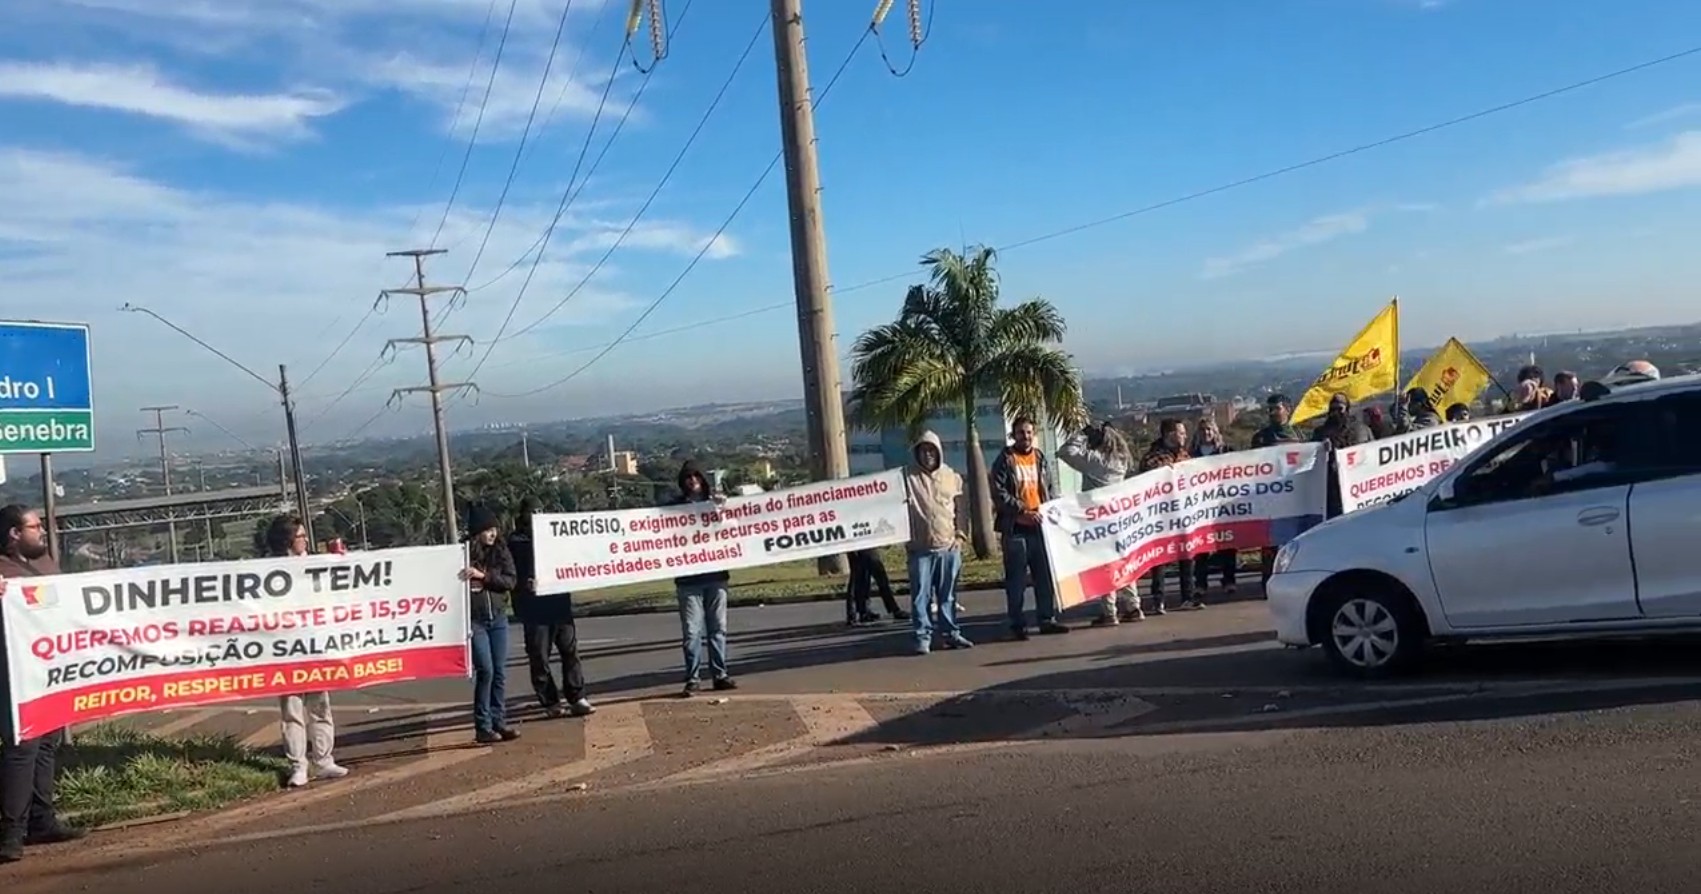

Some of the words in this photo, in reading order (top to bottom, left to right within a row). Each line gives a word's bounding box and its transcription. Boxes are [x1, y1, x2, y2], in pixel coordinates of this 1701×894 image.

[0, 418, 88, 441] enebra
[1379, 425, 1481, 466] DINHEIRO
[1487, 418, 1520, 438] TE
[1085, 493, 1140, 522] SAÚDE
[1143, 480, 1173, 503] NÃO
[1177, 475, 1186, 490] É
[1190, 463, 1273, 487] COMÉRCIO
[1349, 465, 1425, 498] QUEREMOS
[1429, 458, 1459, 476] RE
[550, 515, 625, 537] TARCÍSIO,
[629, 512, 696, 534] exigimos
[701, 501, 761, 528] garantia
[765, 498, 783, 512] do
[787, 479, 888, 509] financiamento
[609, 543, 618, 554] e
[623, 535, 687, 553] aumento
[692, 530, 710, 544] de
[715, 518, 779, 542] recursos
[783, 513, 815, 534] para
[819, 510, 836, 522] as
[1071, 511, 1143, 546] TARCÍSIO,
[1148, 499, 1179, 517] TIRE
[1184, 492, 1198, 509] AS
[1202, 484, 1250, 501] MÃOS
[1256, 480, 1294, 495] DOS
[1114, 520, 1164, 553] NOSSOS
[1169, 502, 1253, 531] HOSPITAIS!
[555, 557, 661, 580] universidades
[666, 543, 743, 567] estaduais!
[764, 524, 846, 551] FORUM
[1167, 542, 1175, 554] É
[1206, 530, 1234, 544] SUS
[81, 569, 292, 616] DINHEIRO
[305, 561, 392, 593] TEM!
[31, 621, 178, 661] QUEREMOS
[188, 607, 326, 637] REAJUSTE
[332, 603, 363, 623] DE
[369, 596, 447, 620] 15,97%
[46, 637, 263, 687] RECOMPOSIÇÃO
[396, 620, 433, 644] JÁ!
[74, 685, 156, 712] REITOR,
[164, 672, 265, 698] RESPEITE
[271, 671, 287, 686] A
[292, 665, 349, 684] DATA
[353, 657, 403, 678] BASE!
